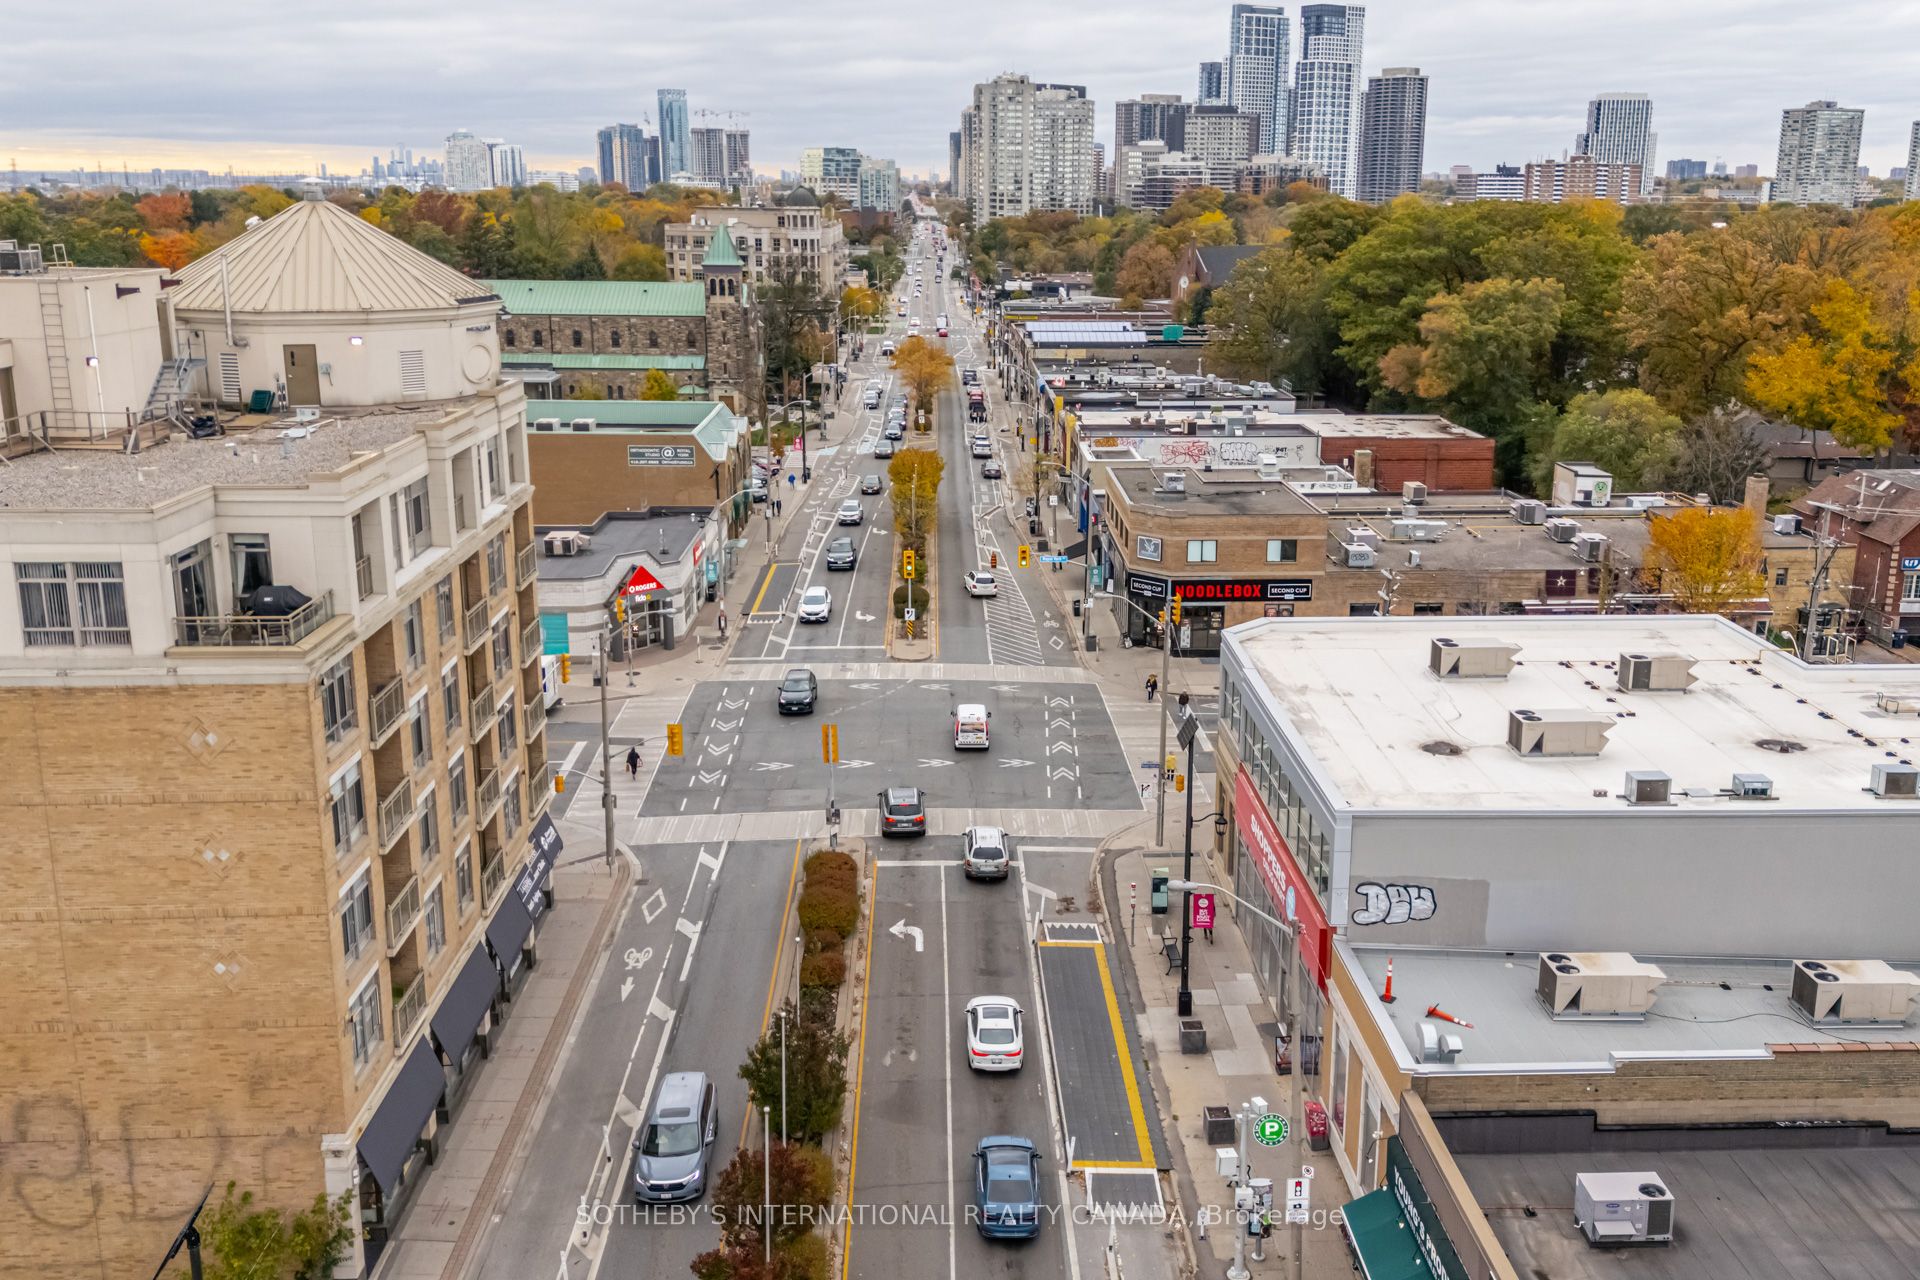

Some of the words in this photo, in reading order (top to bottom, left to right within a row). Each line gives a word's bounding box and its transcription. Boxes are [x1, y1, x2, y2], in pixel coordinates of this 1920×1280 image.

[635, 582, 657, 591] ROGERS
[1133, 581, 1152, 590] SECOND
[1175, 584, 1261, 598] NOODLEBOX
[1250, 813, 1287, 892] SHOPPERS
[1265, 1121, 1280, 1136] P
[1394, 1165, 1426, 1241] YOUNG'S
[1426, 1233, 1450, 1280] PROD
